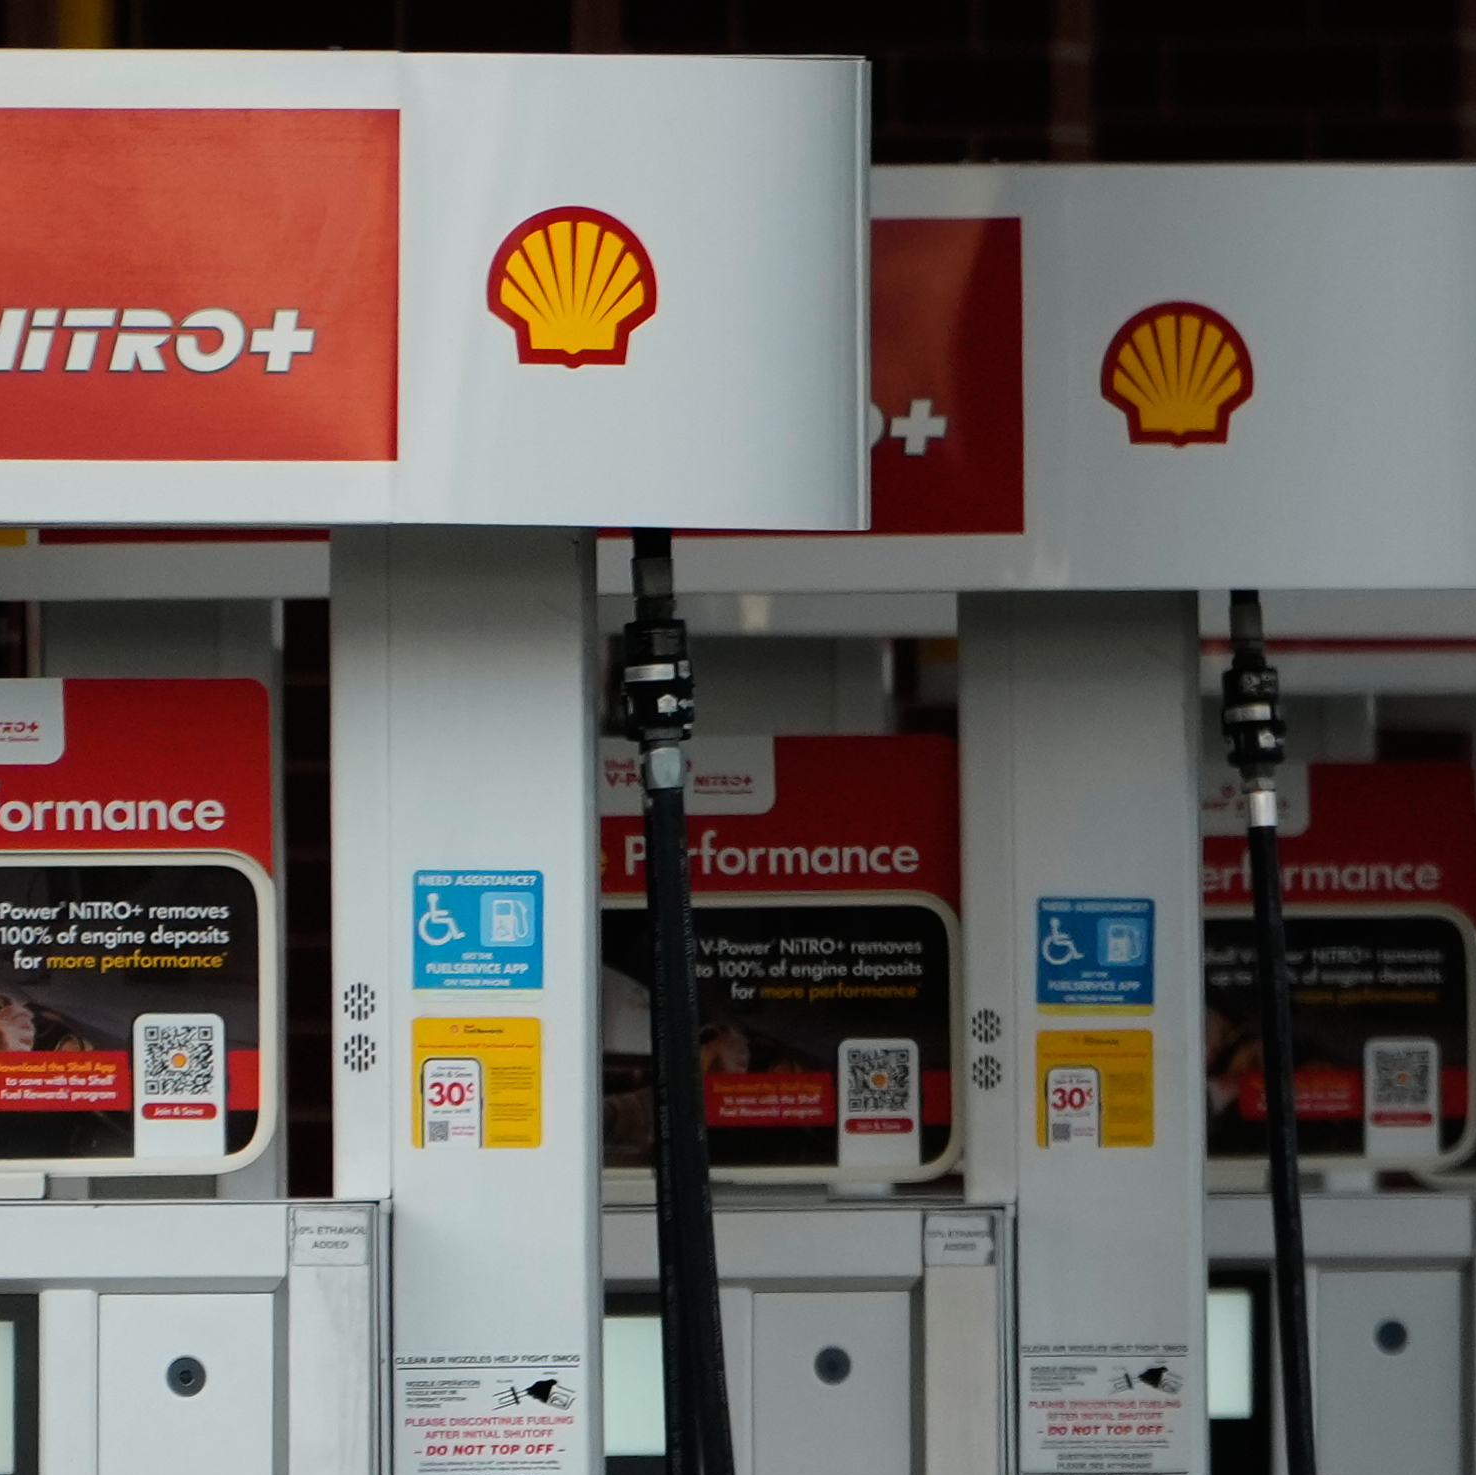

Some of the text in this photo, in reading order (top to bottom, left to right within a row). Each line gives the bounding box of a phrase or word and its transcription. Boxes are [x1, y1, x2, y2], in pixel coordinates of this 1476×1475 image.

[625, 830, 919, 877] Pformance
[455, 875, 536, 886] ASSISTANCE?
[149, 906, 229, 920] removes
[0, 926, 53, 945] 100%
[56, 925, 78, 944] of
[81, 927, 145, 949] engine
[150, 925, 229, 948] deposits
[700, 939, 771, 956] V-Power
[851, 942, 922, 955] removes
[13, 950, 223, 973] for more performance
[504, 963, 529, 974] APP
[696, 959, 923, 982] to 100% of engine deposits
[731, 981, 756, 999] for
[405, 1416, 573, 1427] PLEASE DISCONTINUE FUELING
[424, 1429, 554, 1440] AFTER INITIAL SHUTOFF
[426, 1444, 554, 1456] DO NOT TOP OFF
